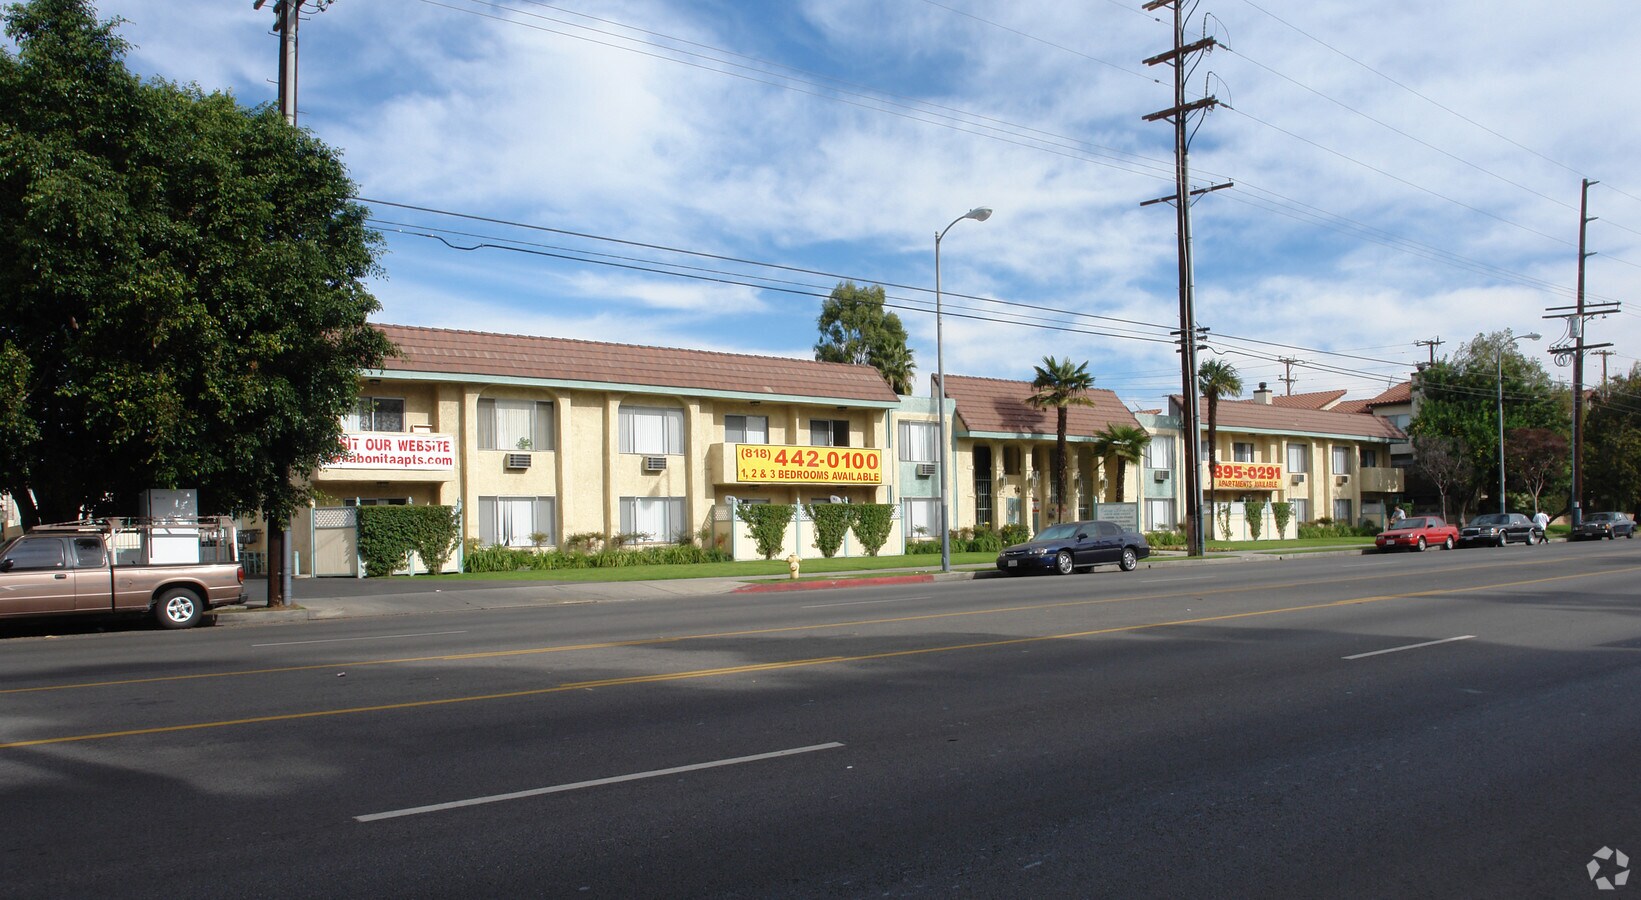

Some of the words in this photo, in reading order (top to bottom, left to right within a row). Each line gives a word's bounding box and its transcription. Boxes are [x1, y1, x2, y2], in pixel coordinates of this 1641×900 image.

[335, 437, 359, 451] SIT
[365, 438, 392, 452] OUR
[398, 440, 450, 452] WEBSITE
[741, 447, 771, 461] (818)
[774, 449, 879, 469] 442-0100
[741, 468, 749, 480] 1,
[751, 468, 757, 478] 2
[760, 469, 767, 478] &
[770, 469, 776, 479] 3
[778, 469, 829, 480] BEDROOMS
[832, 471, 879, 482] AVAILABLE
[1213, 465, 1281, 479] 895-0291
[1218, 480, 1253, 488] APARTMENTS
[1254, 480, 1278, 488] AVAILABLE
